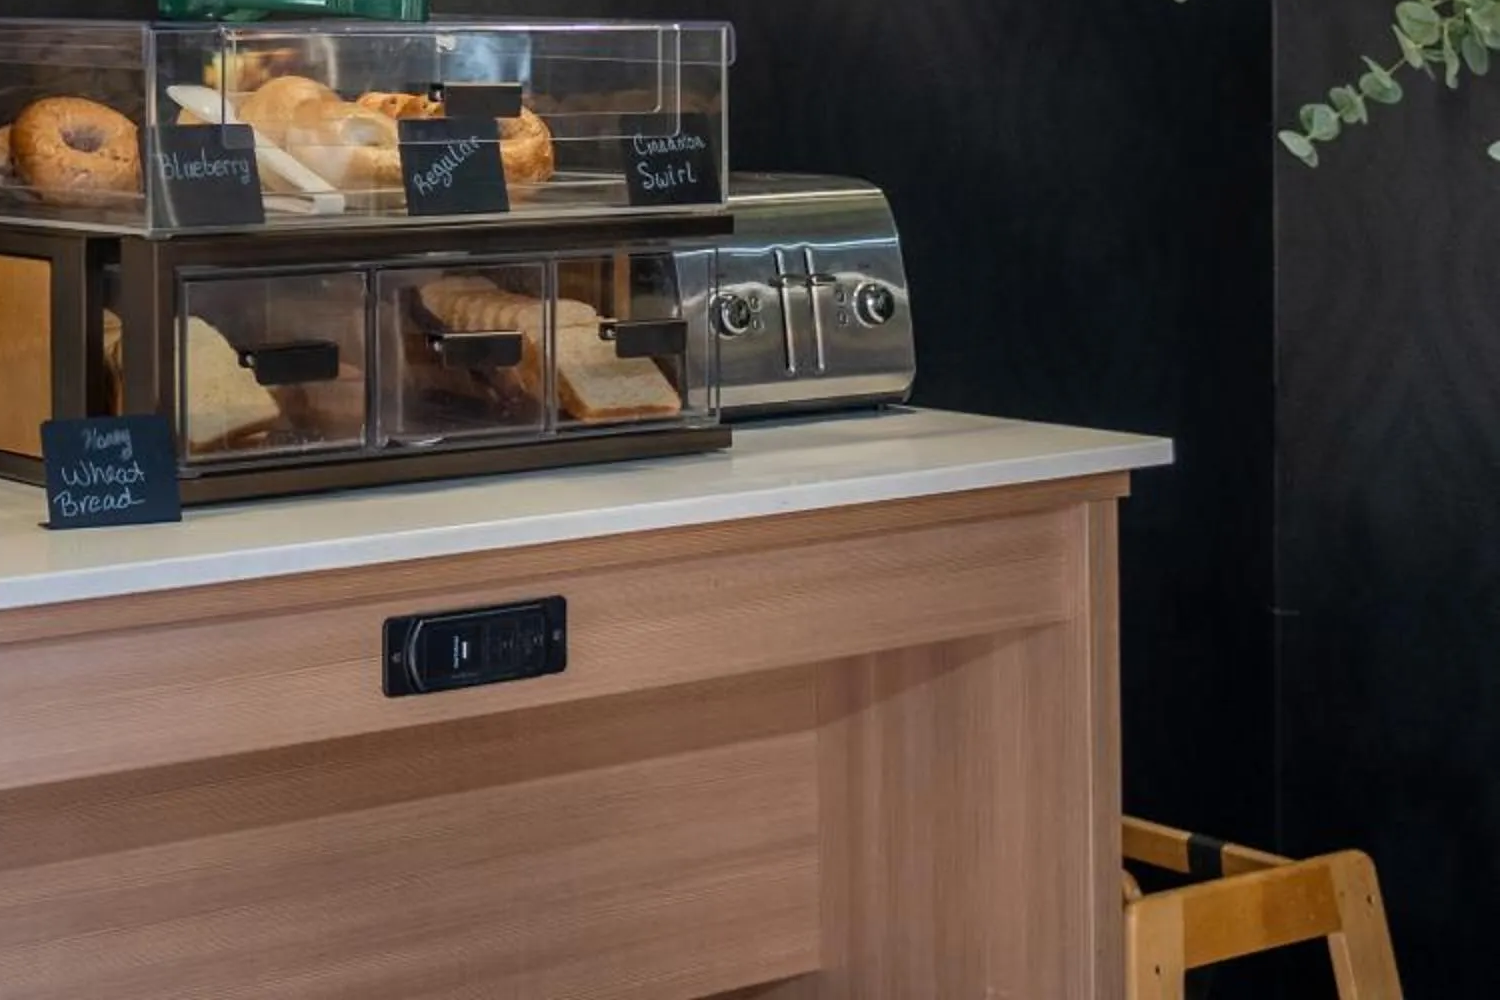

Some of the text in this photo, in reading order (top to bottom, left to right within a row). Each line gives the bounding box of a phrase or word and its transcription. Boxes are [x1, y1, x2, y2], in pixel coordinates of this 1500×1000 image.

[160, 146, 251, 185] Blueberry
[413, 135, 480, 196] Regular
[637, 161, 697, 189] Swirl
[61, 459, 145, 486] Wheat
[53, 487, 146, 518] Bread
